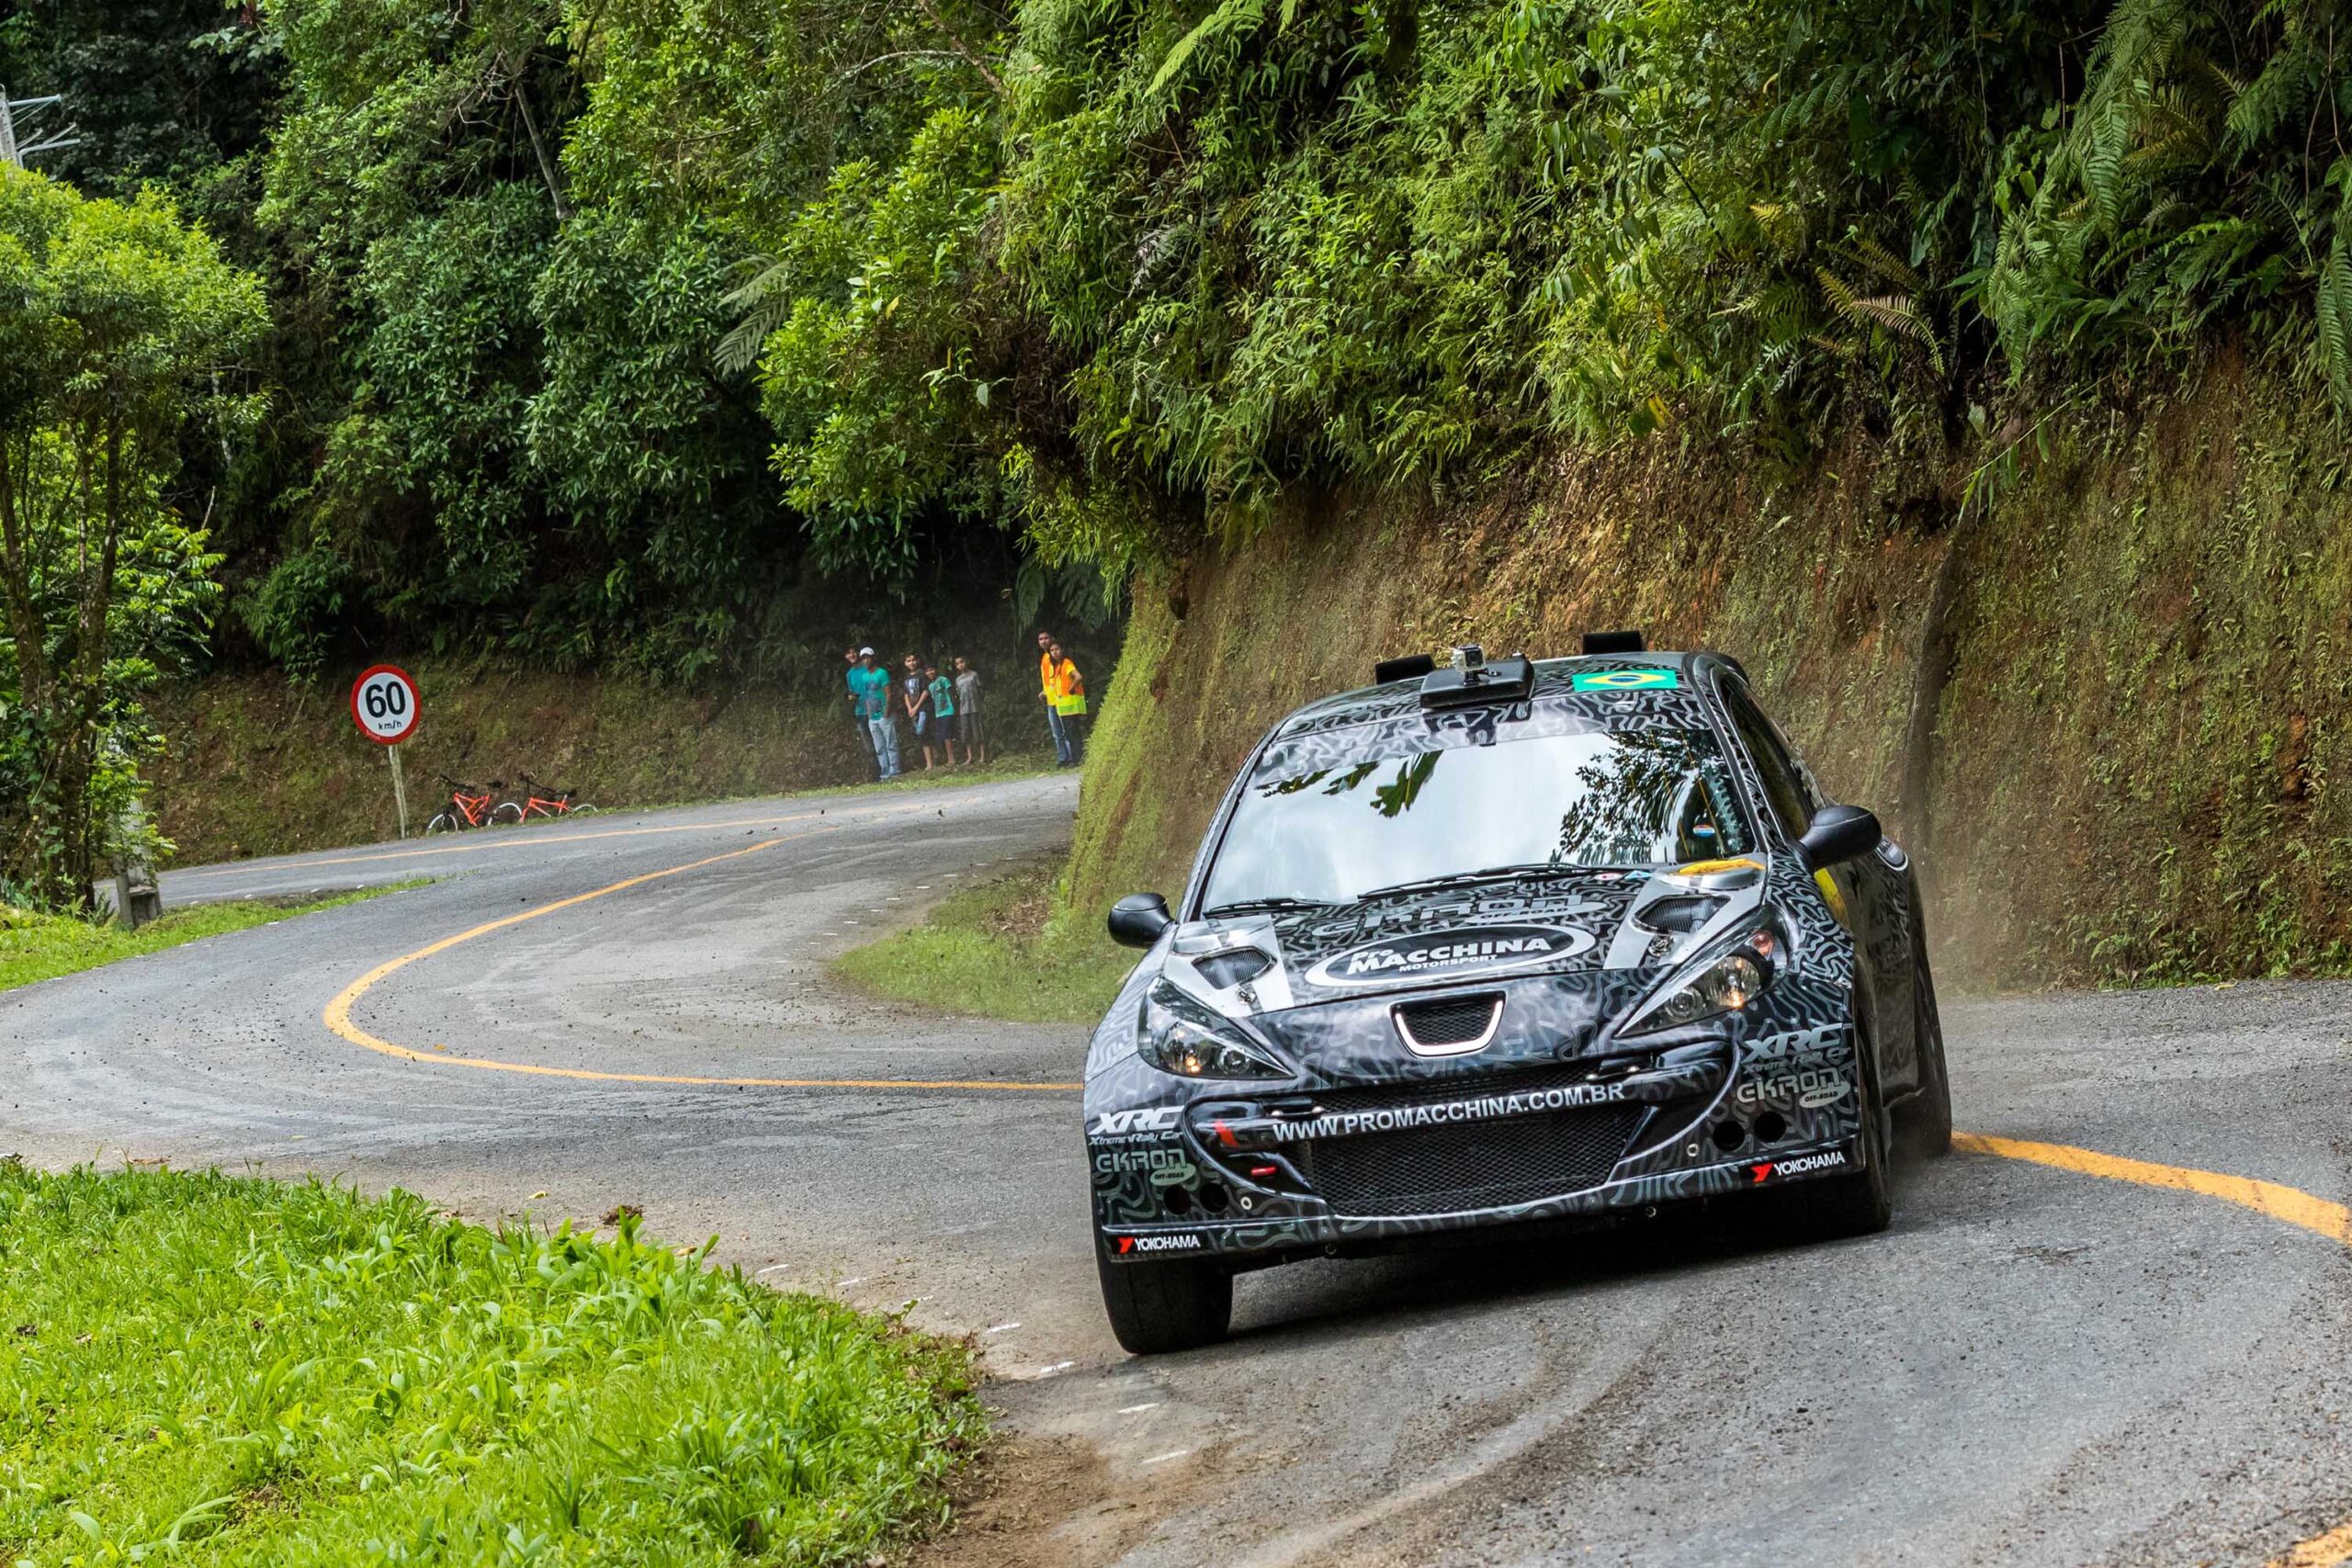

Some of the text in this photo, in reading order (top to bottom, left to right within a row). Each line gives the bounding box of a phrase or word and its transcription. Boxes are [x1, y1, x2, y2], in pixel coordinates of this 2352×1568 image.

[366, 682, 406, 718] 60
[378, 719, 402, 730] km/h
[1346, 938, 1553, 976] MACCHINA
[1398, 954, 1498, 973] MOTORSPORT
[1741, 1022, 1842, 1064] XRC
[1804, 1090, 1838, 1102] OFF-ROAD
[1088, 1105, 1185, 1135] XRC
[1160, 1131, 1183, 1140] Car
[1773, 1150, 1846, 1176] YOKOHAMA
[1135, 1235, 1201, 1250] YOKOHAMA
